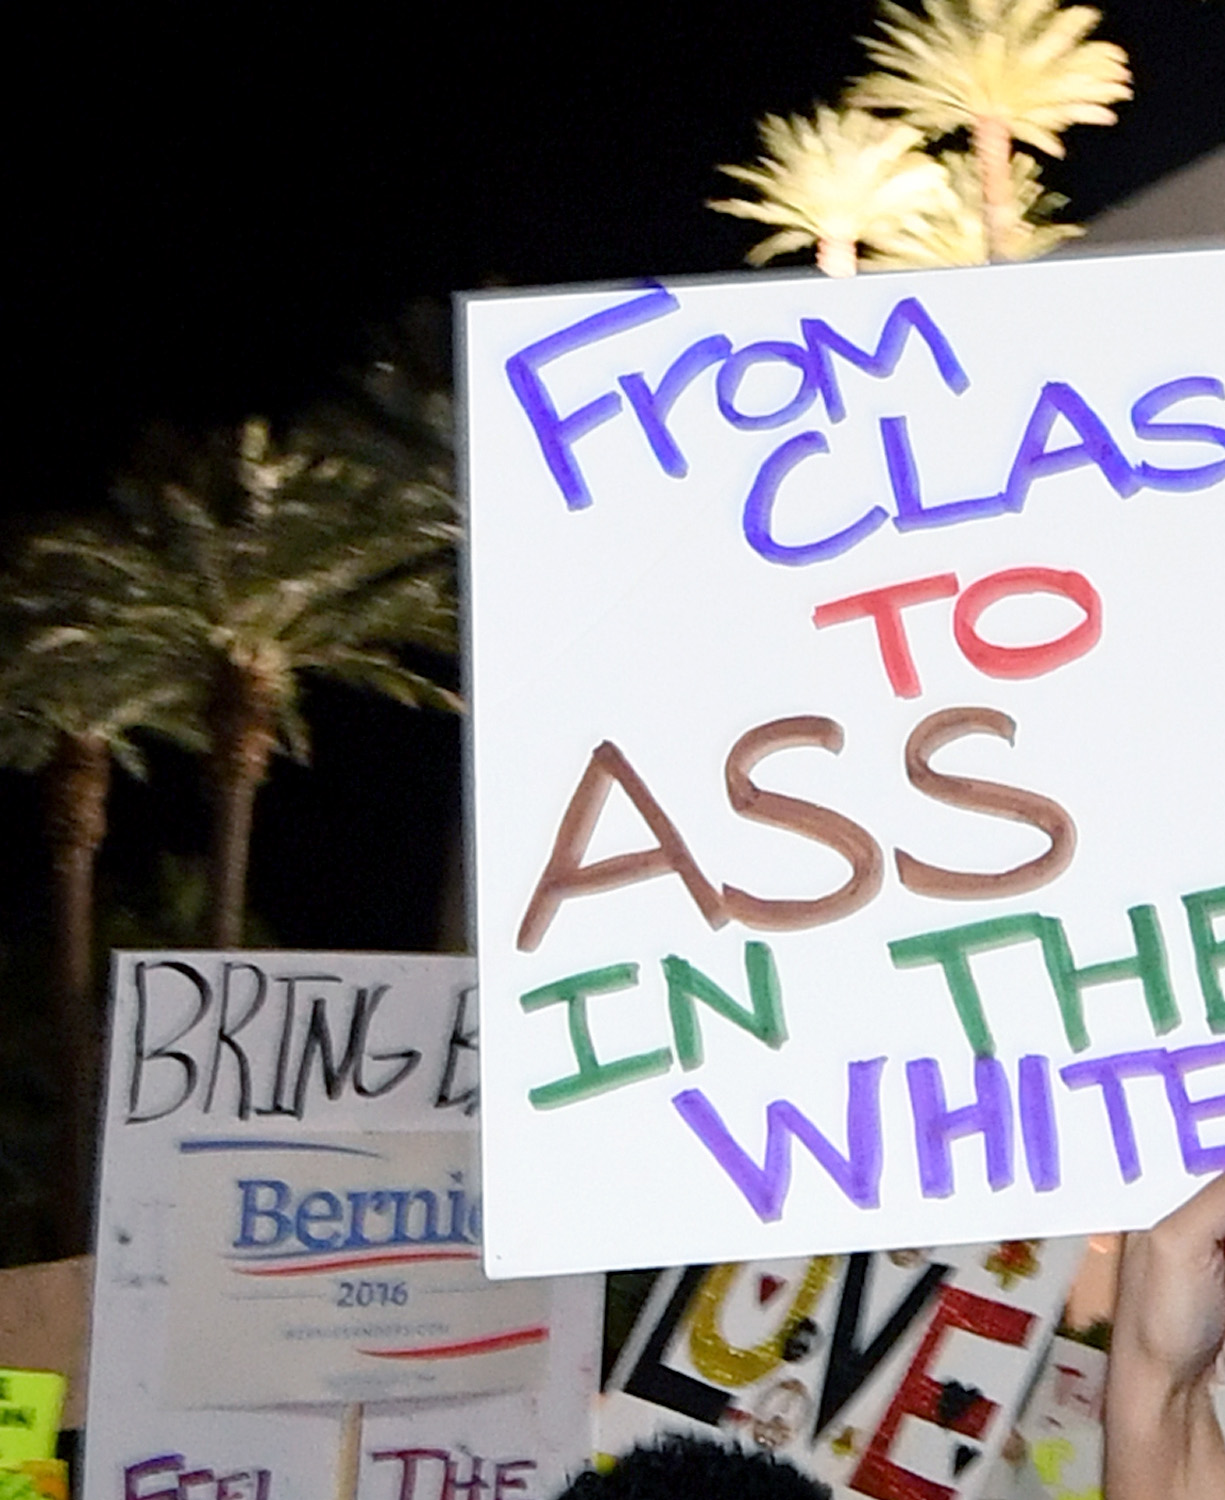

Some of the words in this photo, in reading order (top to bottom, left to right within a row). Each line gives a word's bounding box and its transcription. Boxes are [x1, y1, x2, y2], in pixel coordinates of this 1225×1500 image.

[812, 566, 1103, 700] TO
[516, 706, 1077, 953] ASS
[125, 960, 422, 1125] BRING
[519, 940, 789, 1111] IN
[335, 1281, 410, 1310] 2016
